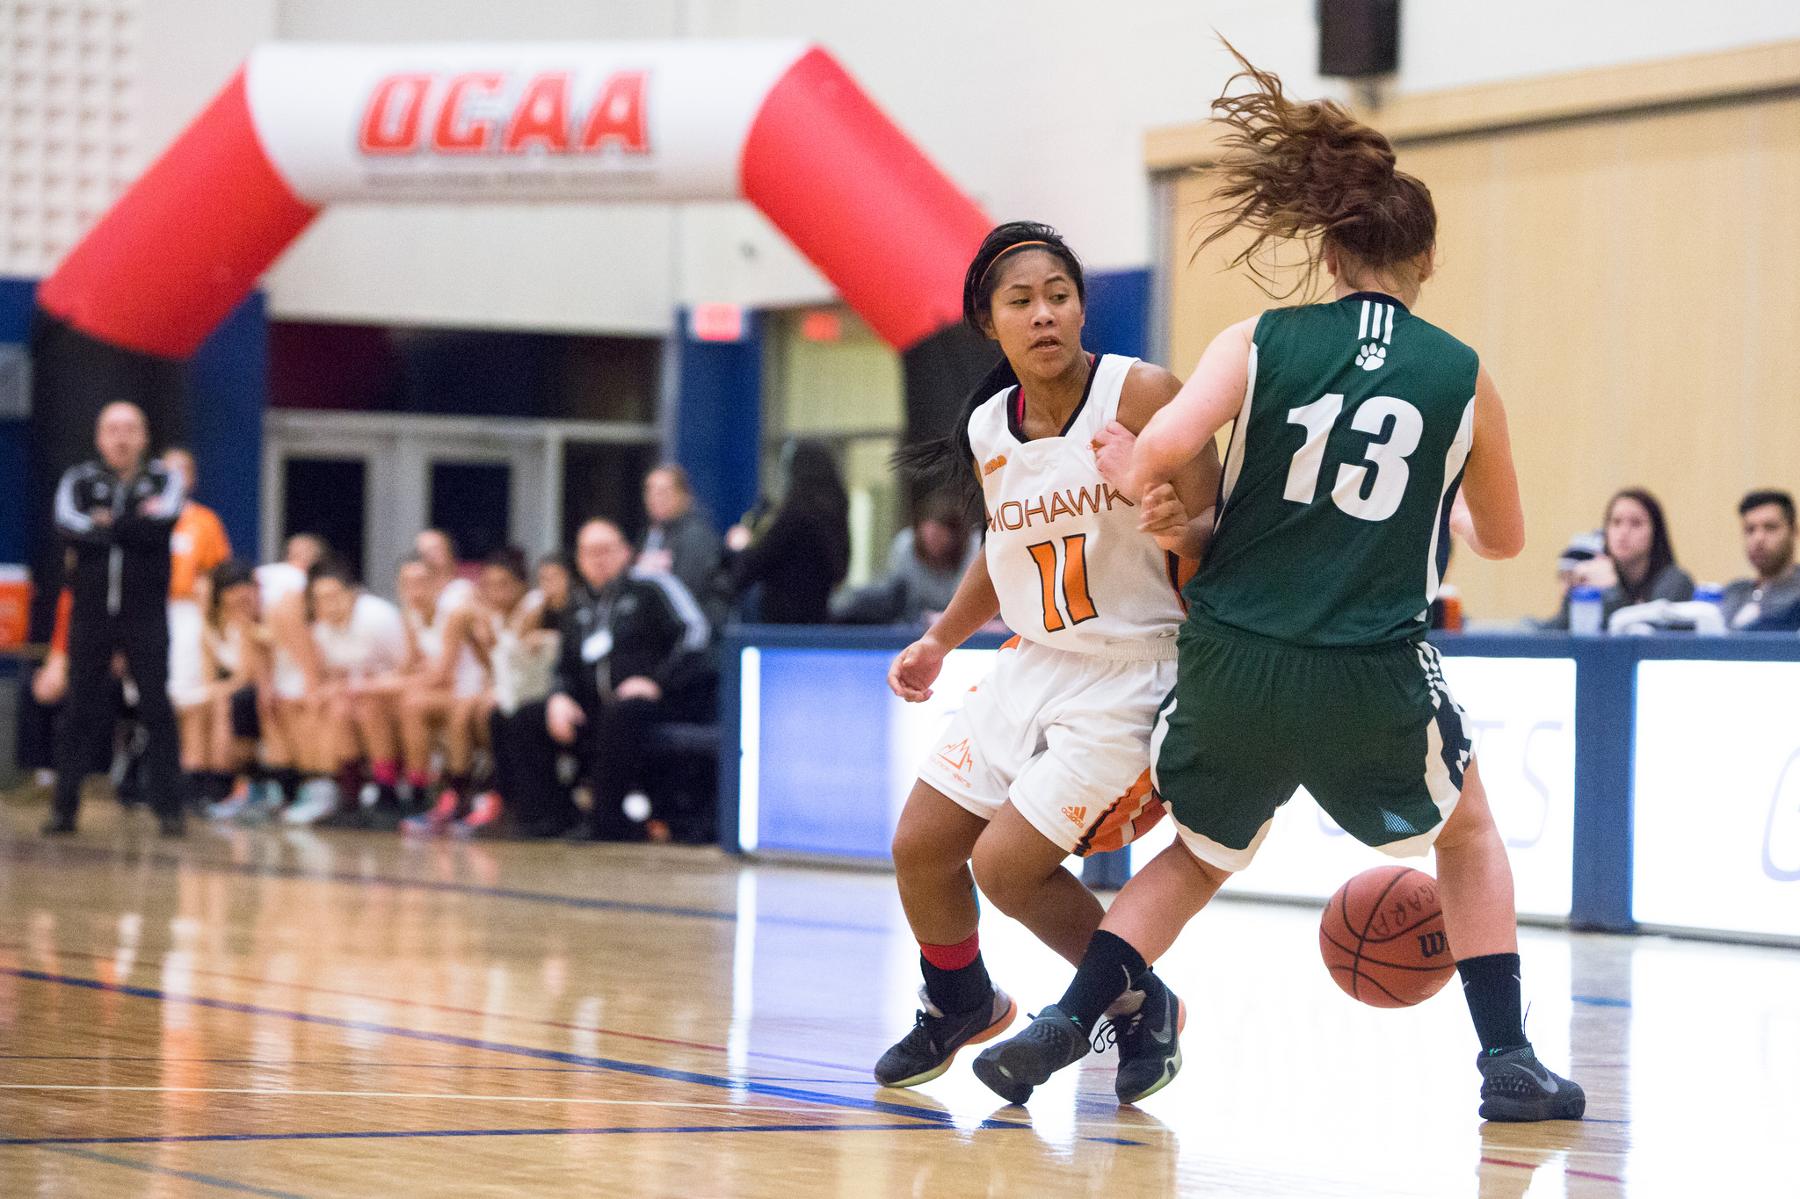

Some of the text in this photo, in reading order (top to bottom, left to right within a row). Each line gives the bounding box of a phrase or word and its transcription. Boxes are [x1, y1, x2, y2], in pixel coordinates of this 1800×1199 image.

[359, 71, 651, 155] OCAA
[1283, 393, 1423, 521] 13
[1027, 533, 1099, 633] 11
